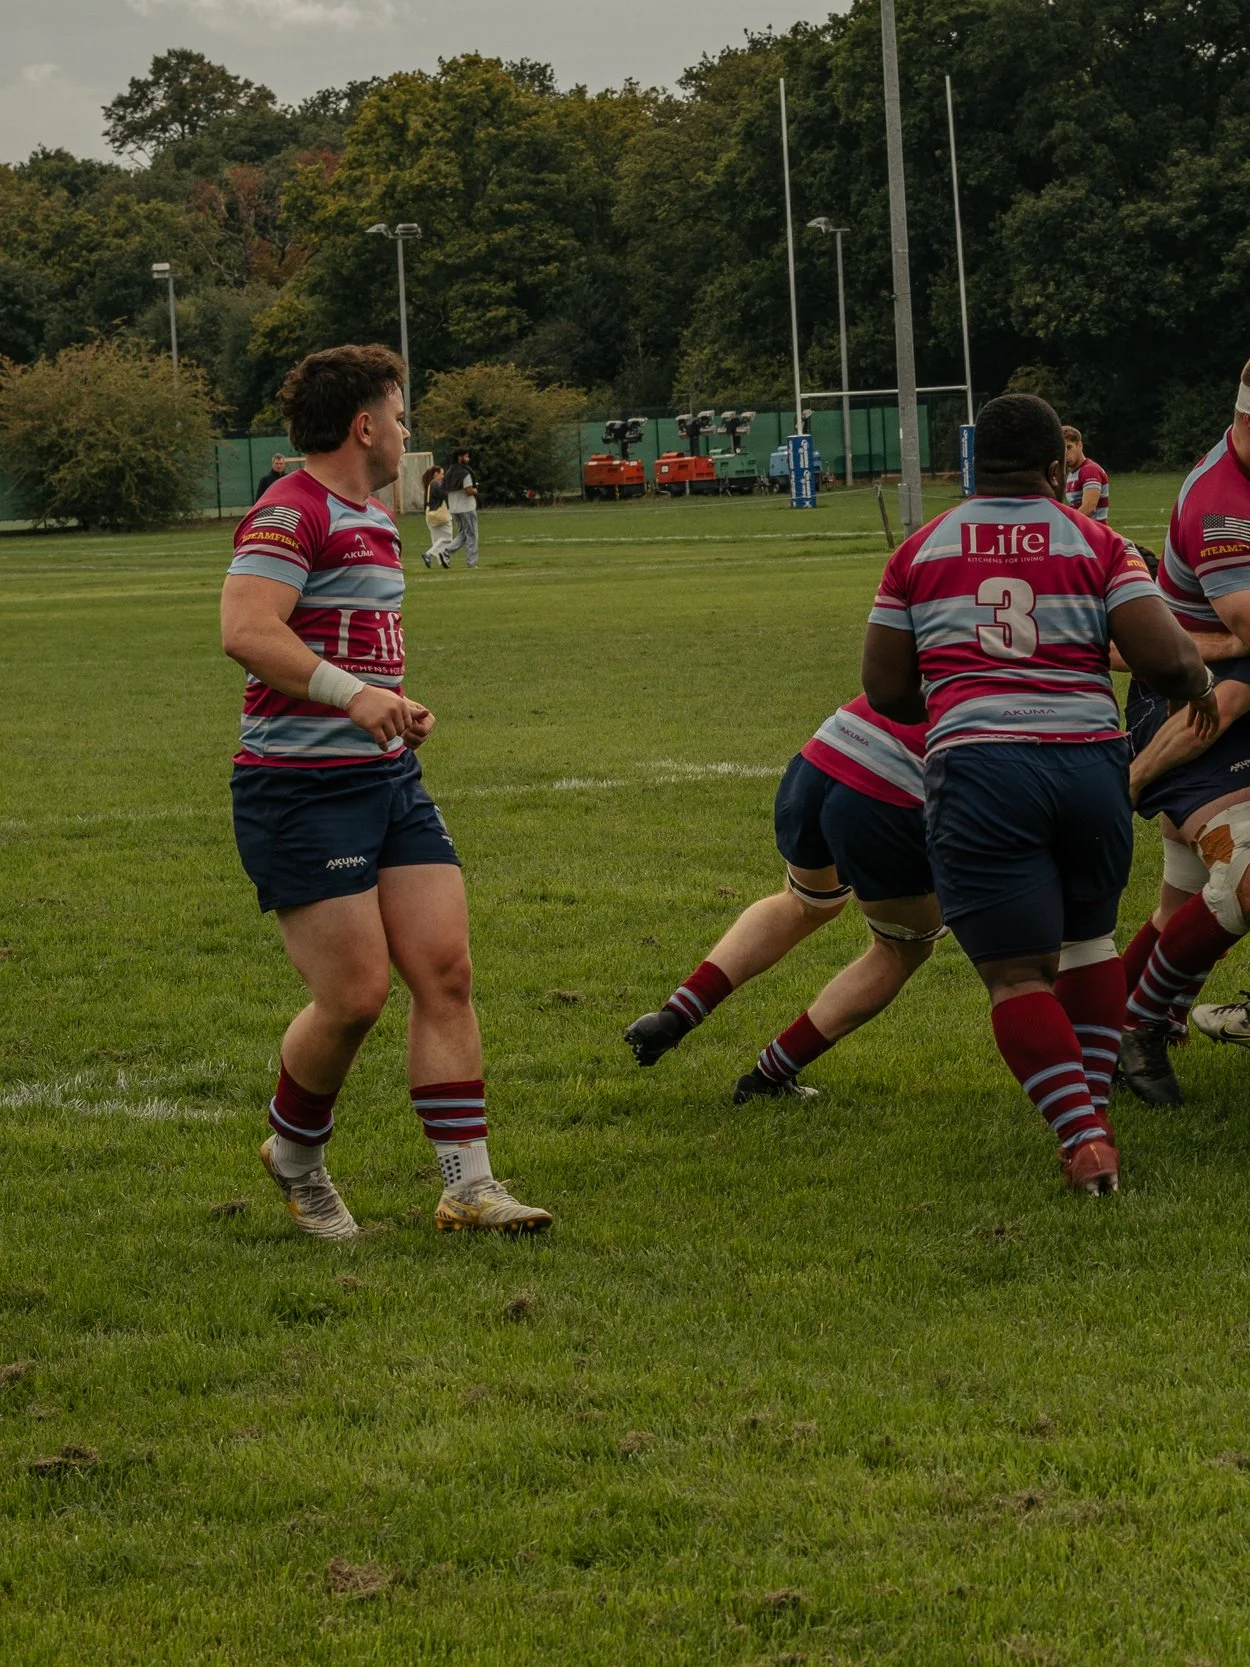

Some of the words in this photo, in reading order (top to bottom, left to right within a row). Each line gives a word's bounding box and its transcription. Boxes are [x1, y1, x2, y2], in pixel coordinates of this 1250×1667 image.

[966, 523, 1045, 555] Life
[342, 550, 374, 560] AKUMA
[967, 556, 1003, 564] KITCHENS
[976, 575, 1040, 660] 3
[337, 663, 388, 673] TCHENS
[1002, 708, 1057, 717] AKUMA
[840, 726, 870, 747] AKUMA
[326, 855, 368, 869] AKUMA
